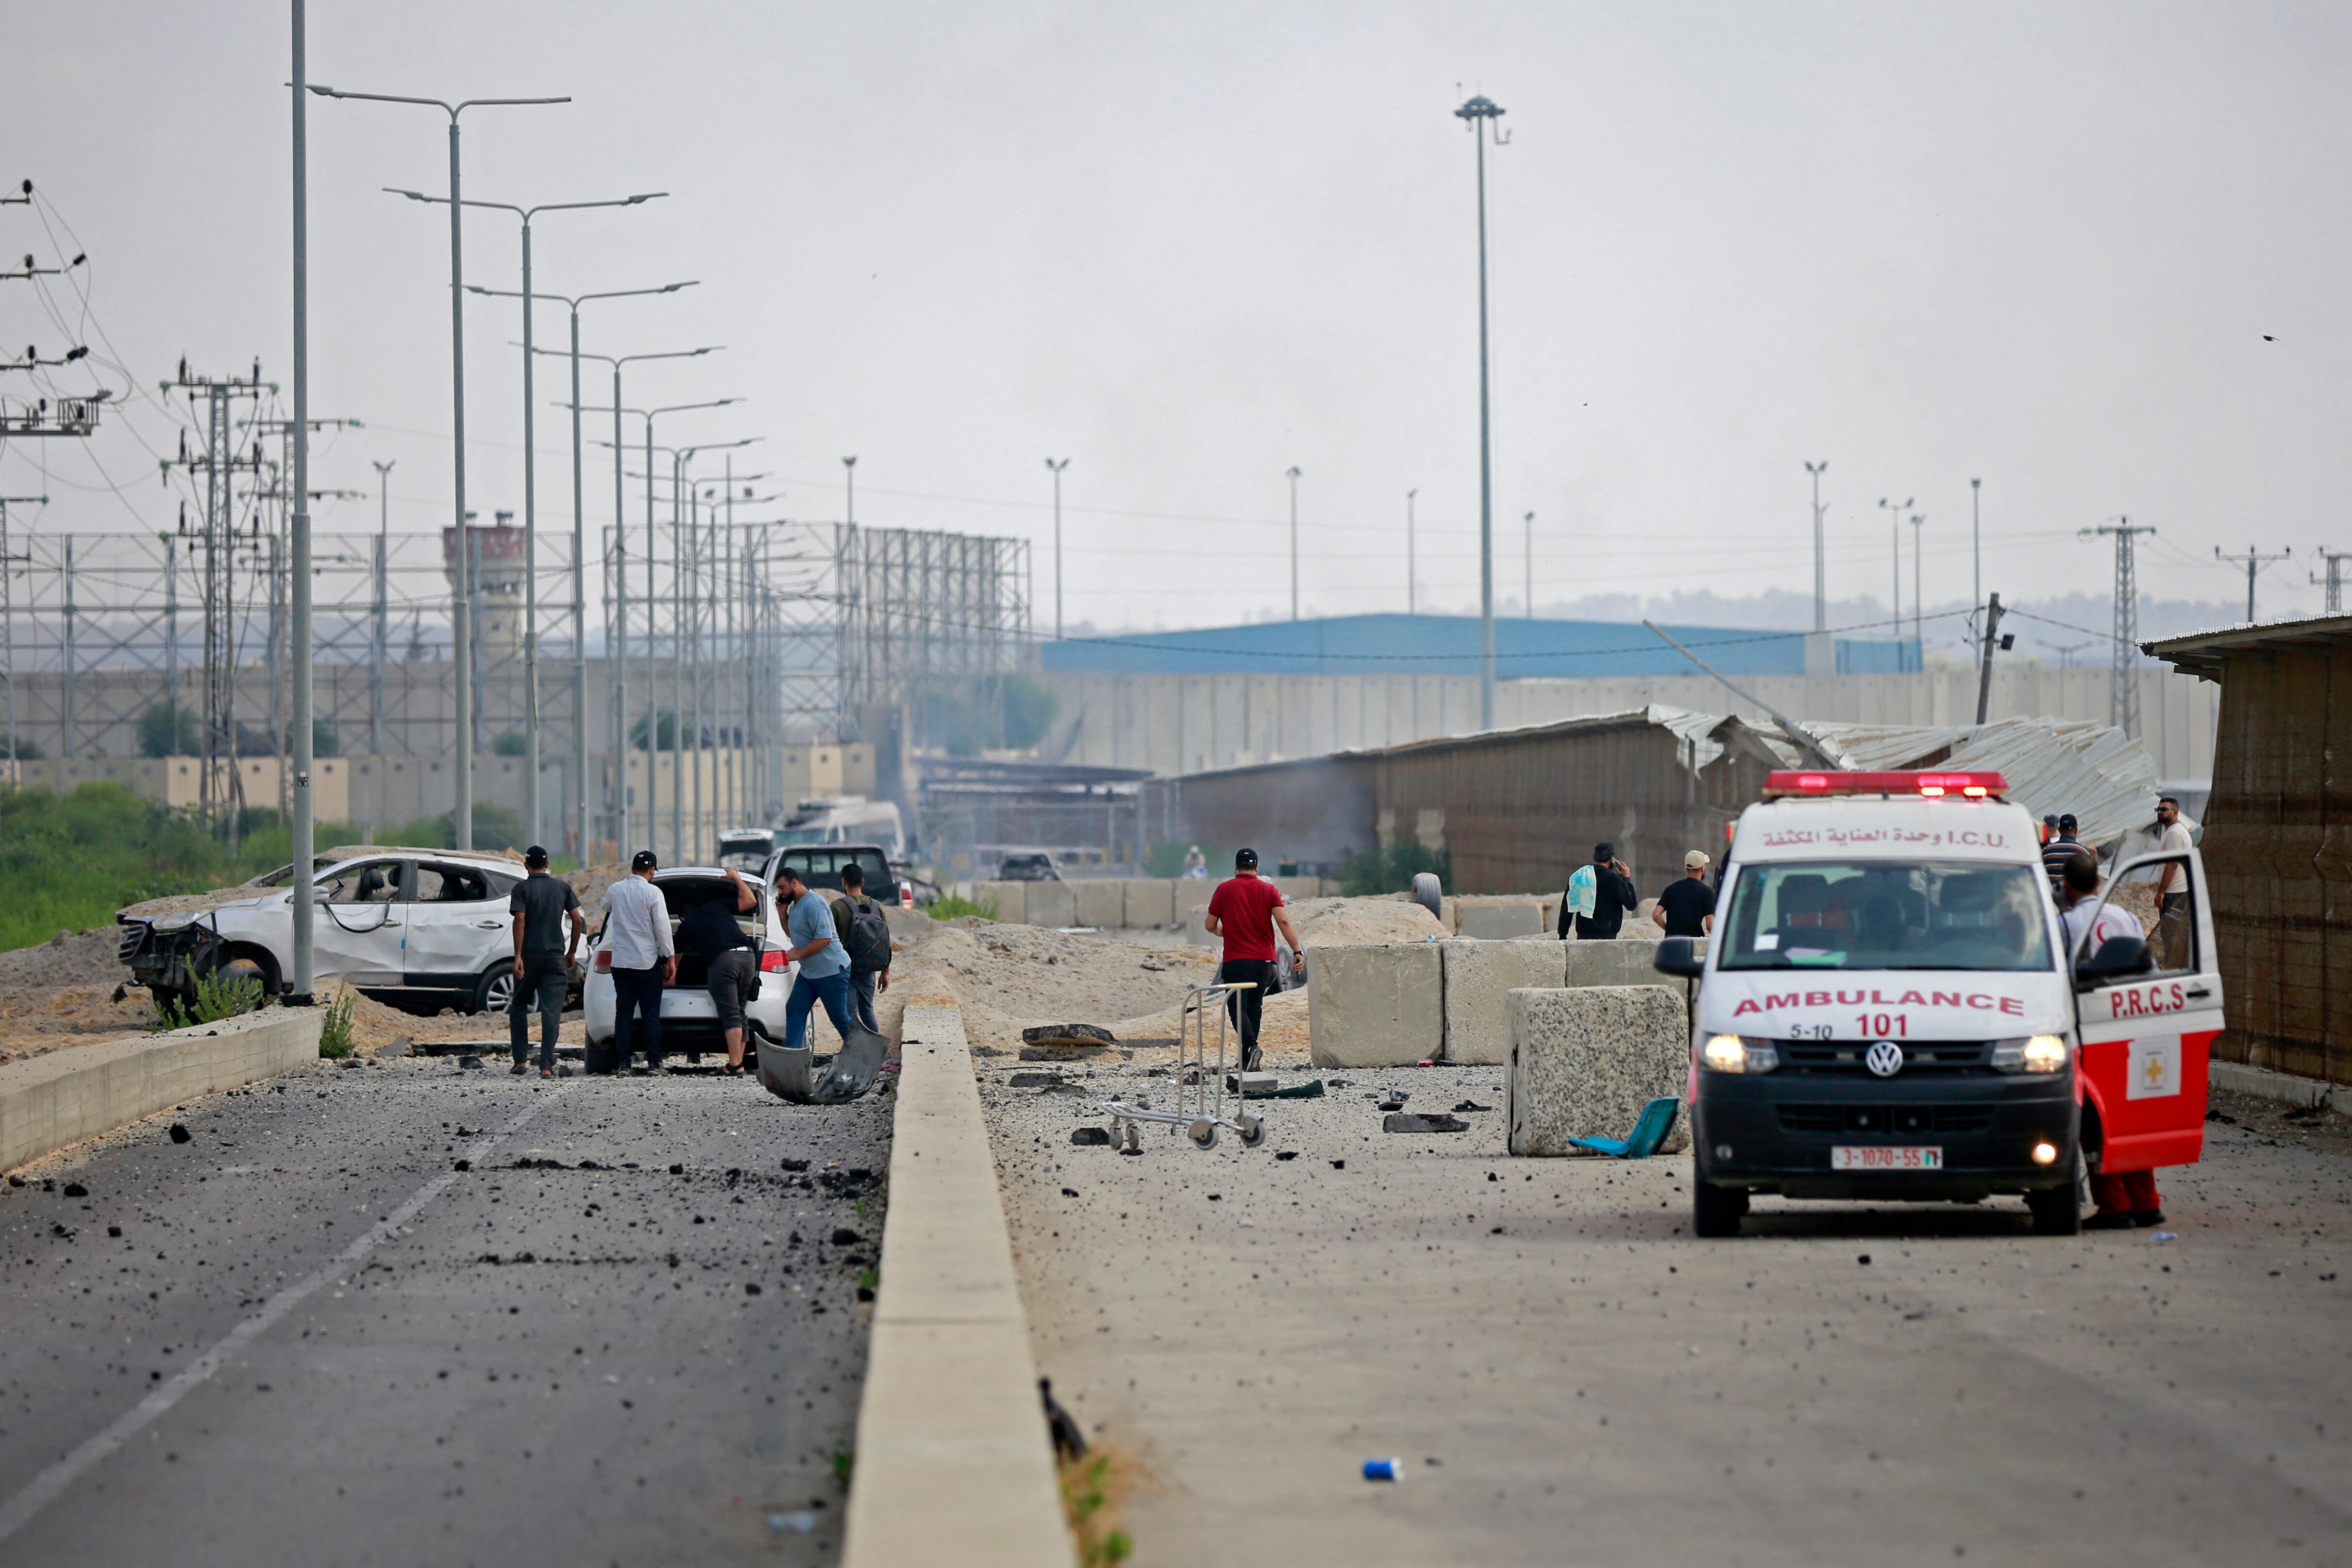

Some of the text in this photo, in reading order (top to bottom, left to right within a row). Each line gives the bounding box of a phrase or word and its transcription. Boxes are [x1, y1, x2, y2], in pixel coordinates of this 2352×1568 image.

[1827, 828, 1887, 846] العناية
[1894, 827, 1941, 846] وحدة
[1948, 830, 2010, 849] I.C.U.
[1732, 990, 2025, 1017] AMBULANCE
[2110, 983, 2184, 1018] P.R.C.S
[1790, 1024, 1833, 1040] 5-10
[1856, 1013, 1907, 1037] 101
[1844, 1148, 1921, 1166] 3-1070-55
